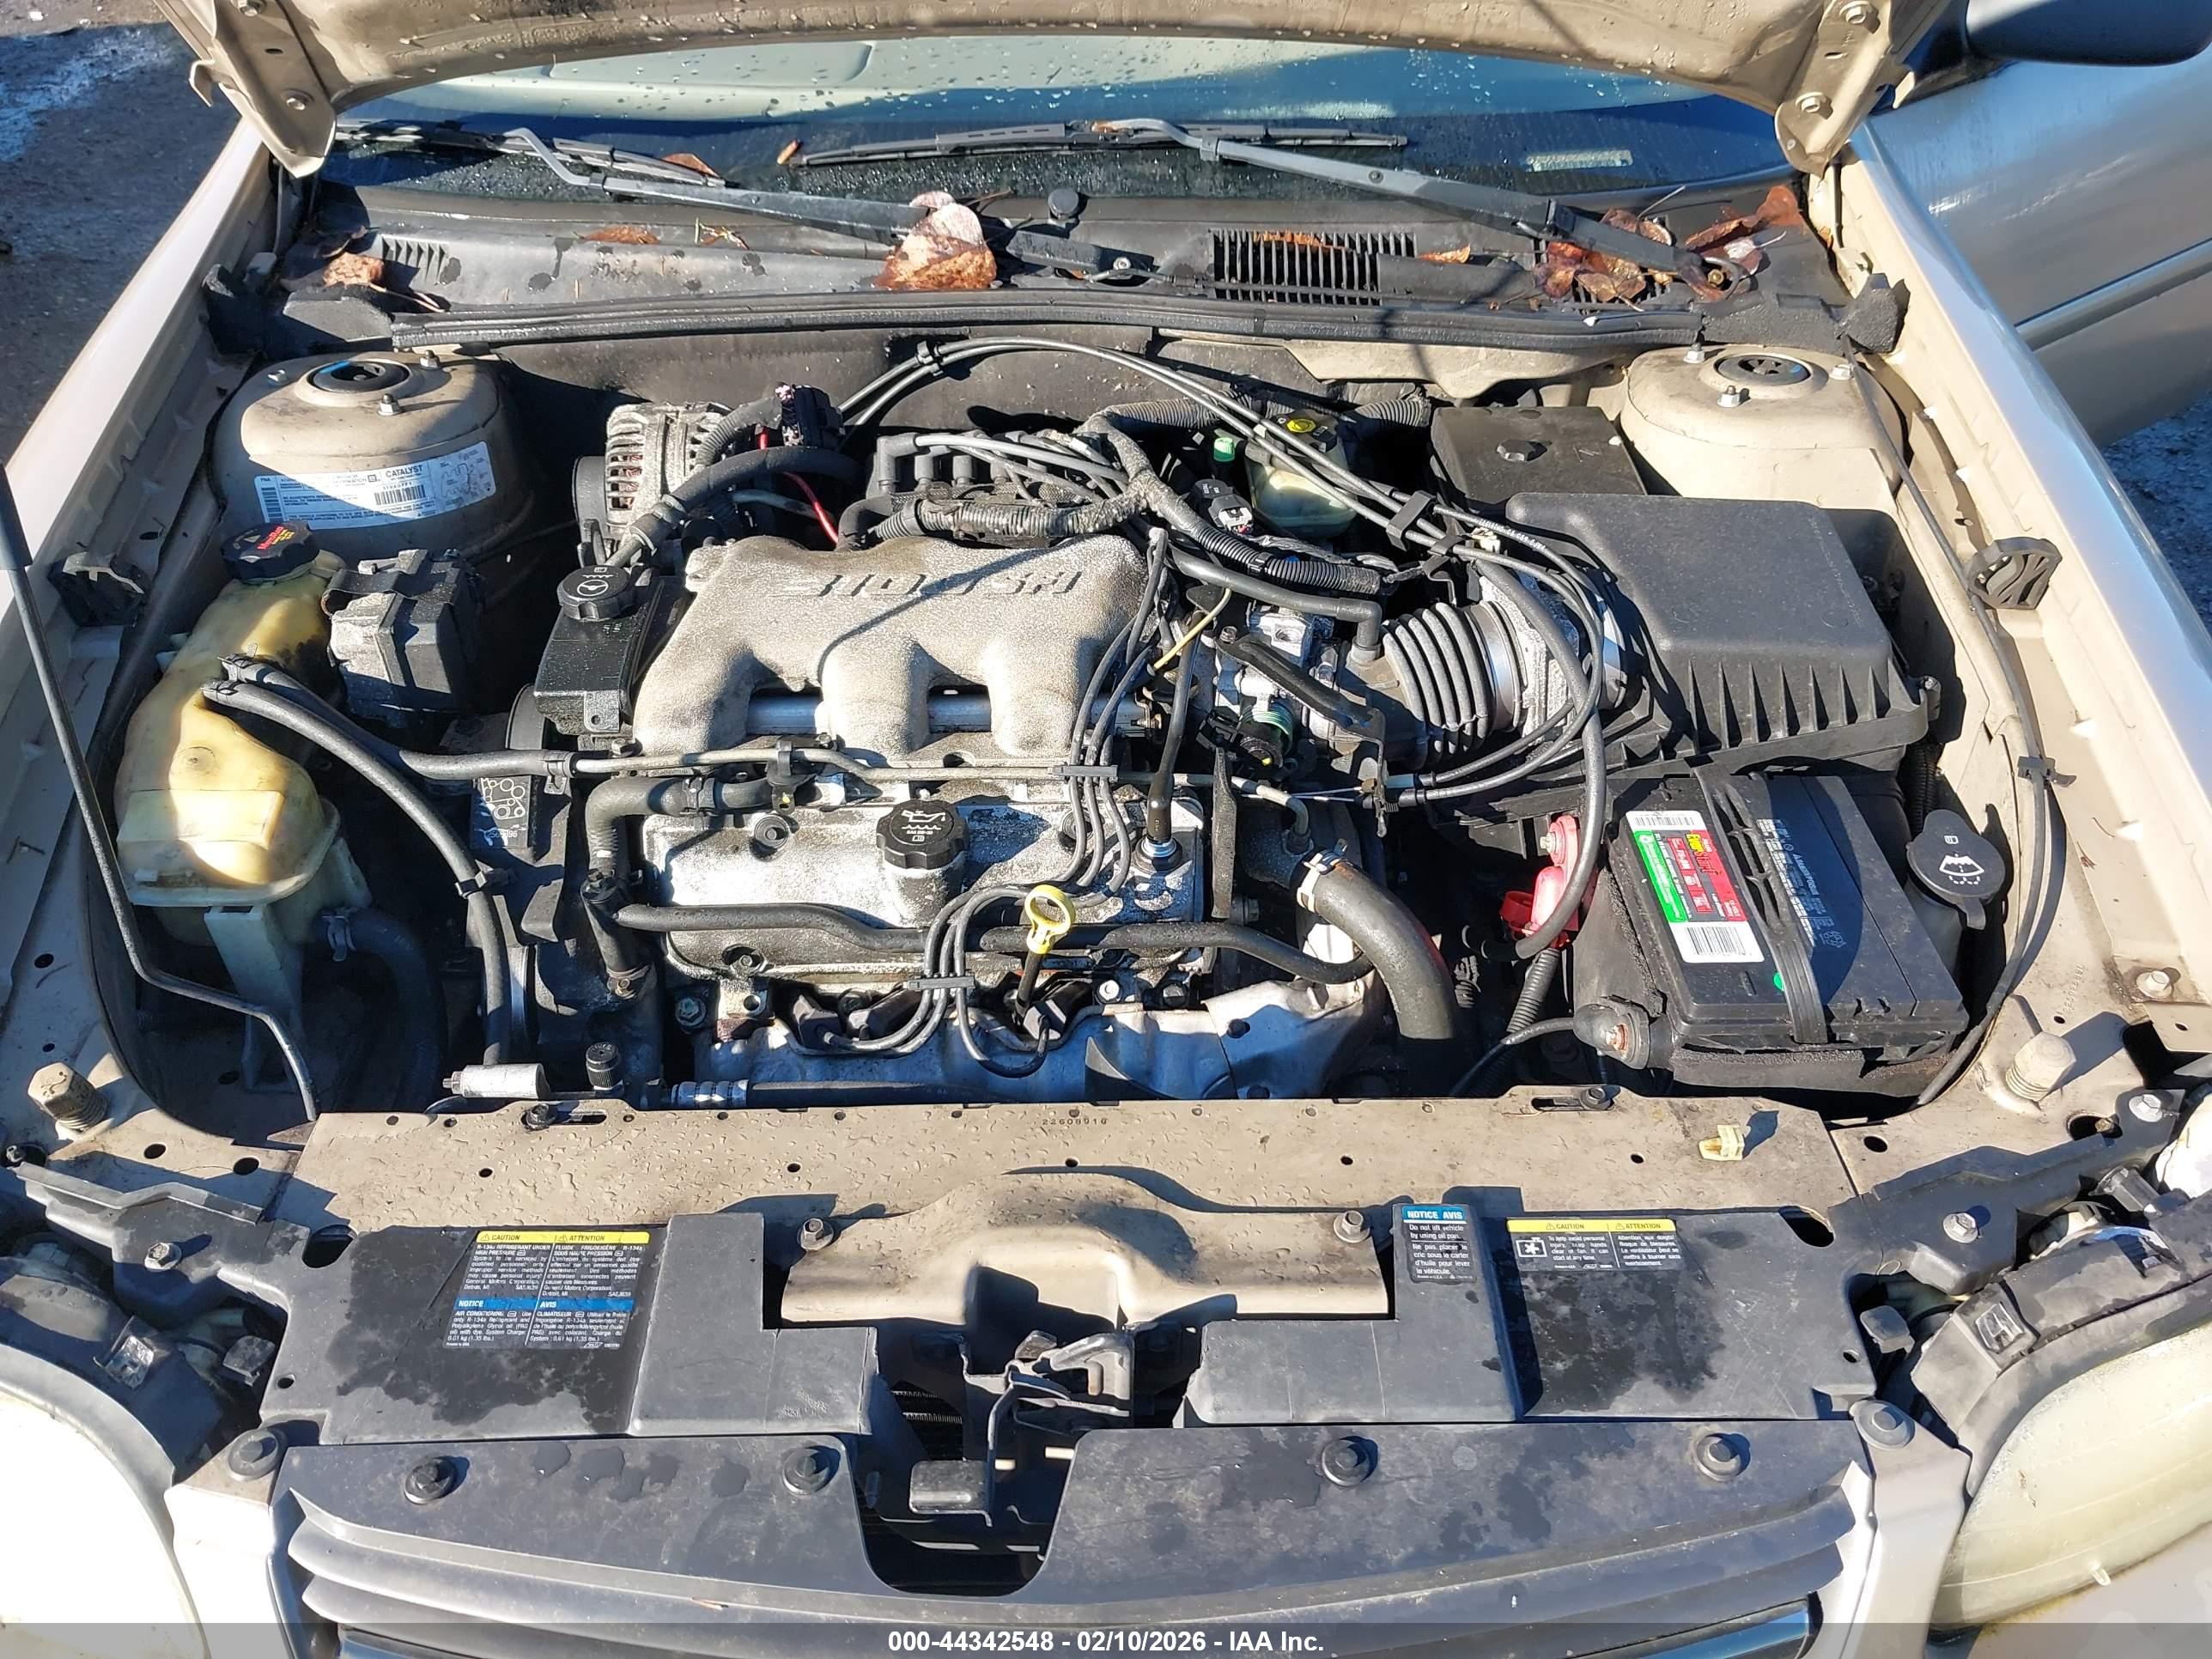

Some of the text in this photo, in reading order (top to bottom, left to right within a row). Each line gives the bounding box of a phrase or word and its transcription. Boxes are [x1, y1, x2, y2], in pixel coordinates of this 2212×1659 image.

[385, 464, 422, 479] CATALYST
[1407, 1211, 1463, 1219] NOTICE AVIS
